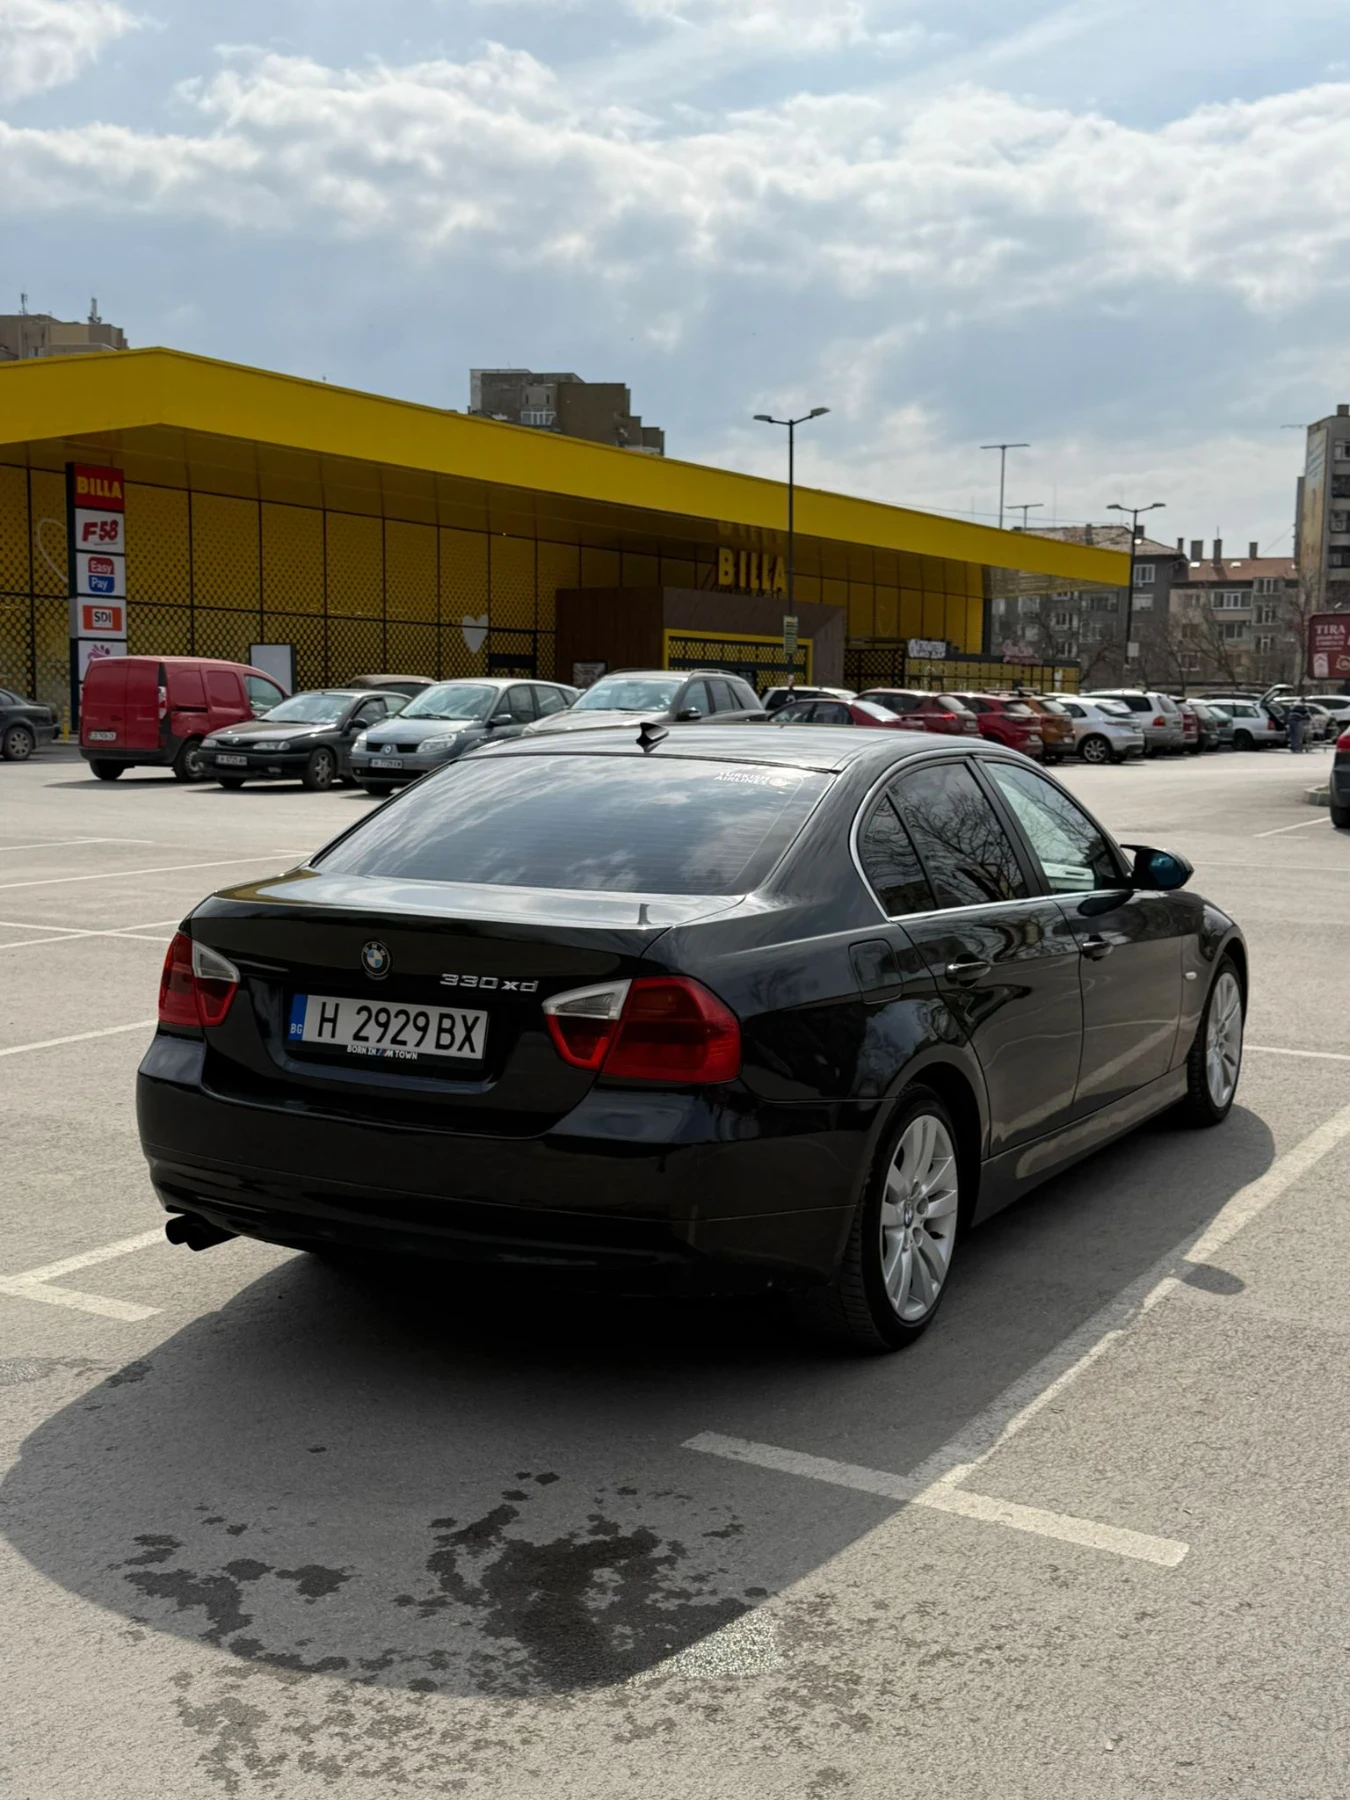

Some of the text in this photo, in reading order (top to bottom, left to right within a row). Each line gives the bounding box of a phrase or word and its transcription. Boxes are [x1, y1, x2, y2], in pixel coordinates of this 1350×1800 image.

[76, 476, 122, 499] BILLA
[82, 519, 119, 542] F58
[90, 560, 112, 574] Easy
[718, 547, 788, 592] BILLA
[91, 577, 109, 590] Pay
[94, 611, 112, 623] SDI
[317, 1001, 340, 1038] H
[290, 1023, 303, 1034] BG
[347, 1045, 366, 1054] BORN
[395, 1051, 418, 1060] TOWN
